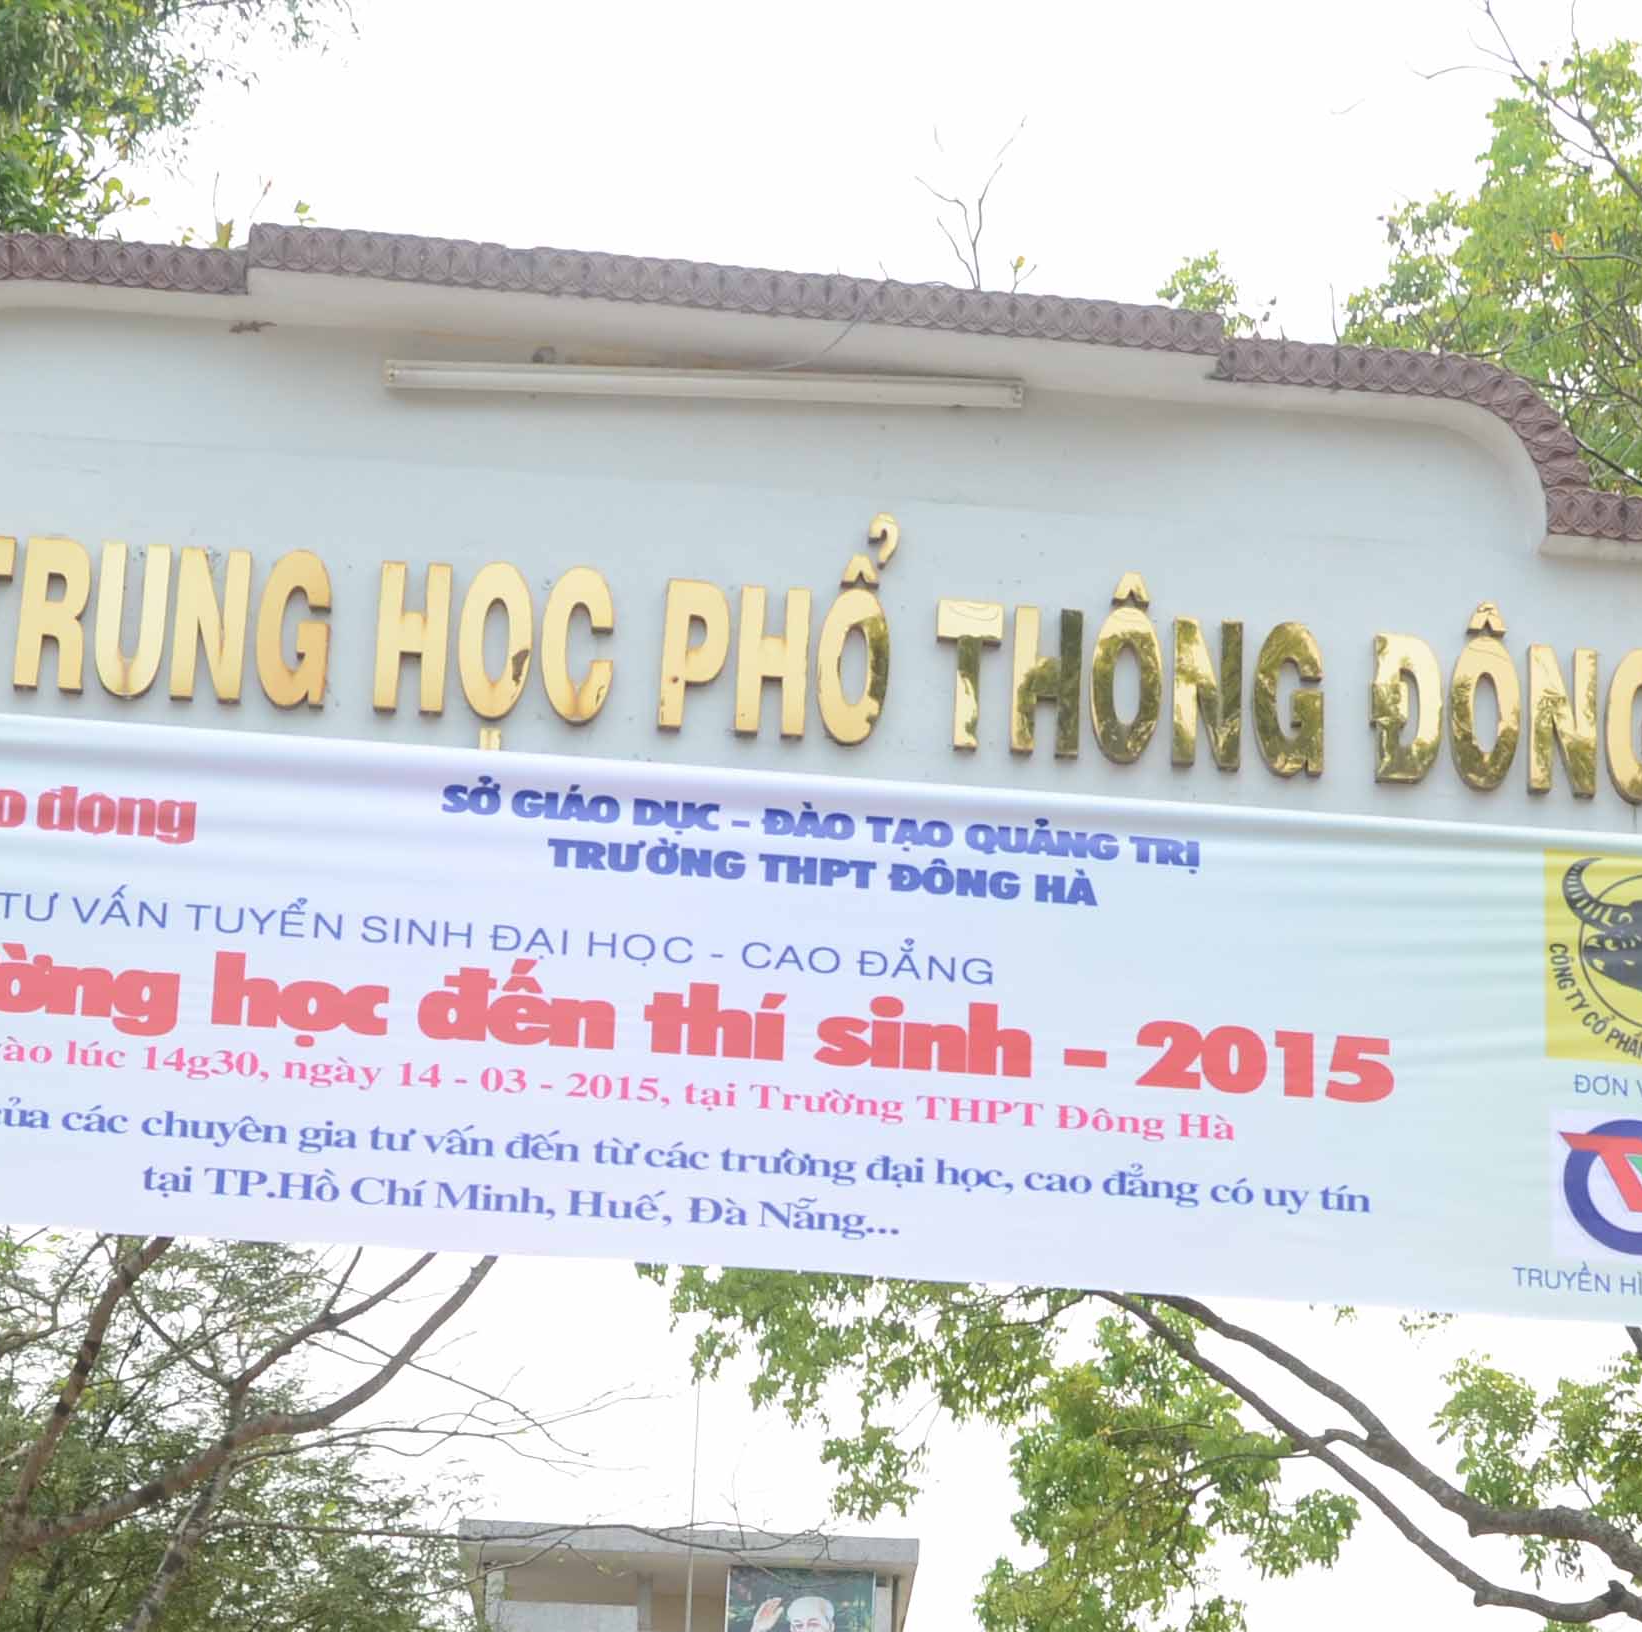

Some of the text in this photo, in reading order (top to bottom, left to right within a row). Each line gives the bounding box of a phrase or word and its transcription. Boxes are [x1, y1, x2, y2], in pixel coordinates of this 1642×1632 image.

[373, 560, 616, 752] HỌC
[658, 513, 899, 748] PHỔ
[937, 571, 1326, 778] THÔNG
[441, 775, 503, 815] SỞ
[512, 785, 621, 823] GIÁO
[633, 800, 720, 836] DỤC
[761, 800, 855, 839] ĐÀO
[865, 815, 954, 850] TẠO
[965, 819, 1120, 861] QUẢNG
[1129, 834, 1200, 875] TRỊ
[547, 832, 1097, 906] TRƯỜNG THPT ĐÔNG HÀ
[73, 885, 167, 928] VẤN
[185, 898, 343, 940] TUYỂN
[361, 916, 472, 948] SINH
[489, 925, 567, 971] ĐẠI
[588, 932, 693, 966] HỌC
[742, 942, 840, 974] CAO
[857, 938, 993, 984] ĐẲNG
[211, 952, 389, 1047] học
[418, 962, 615, 1050] đến
[645, 982, 786, 1060] thí
[815, 996, 1031, 1078] sinh
[1136, 1021, 1394, 1102] 2015
[67, 1040, 125, 1068] lúc
[147, 1046, 269, 1080] 14g30,
[285, 1050, 381, 1090] ngày
[401, 1062, 441, 1088] 14
[481, 1068, 527, 1093] 03
[567, 1073, 669, 1104] 2015,
[685, 1084, 735, 1110] tại
[751, 1085, 903, 1123] Trường
[917, 1094, 1043, 1126] THPT
[1059, 1106, 1164, 1140] Đông
[1178, 1110, 1237, 1140] Hà
[1573, 1074, 1627, 1096] ĐƠN
[62, 1105, 127, 1134] các
[141, 1111, 287, 1147] chuyên
[299, 1120, 357, 1152] gia
[371, 1126, 417, 1151] tư
[424, 1125, 493, 1156] vấn
[505, 1130, 579, 1162] đến
[595, 1138, 640, 1164] từ
[645, 1142, 709, 1170] các
[721, 1148, 856, 1185] trường
[867, 1156, 923, 1188] đại
[937, 1160, 1013, 1192] học,
[1025, 1173, 1092, 1193] cao
[1103, 1164, 1199, 1208] đẳng
[1211, 1178, 1253, 1204] có
[1265, 1188, 1309, 1214] uy
[1320, 1186, 1369, 1212] tín
[143, 1166, 899, 1240] tại TP.Hồ Chí Minh, Huế, Đà Nẵng...
[1513, 1262, 1610, 1294] TRUYỀN
